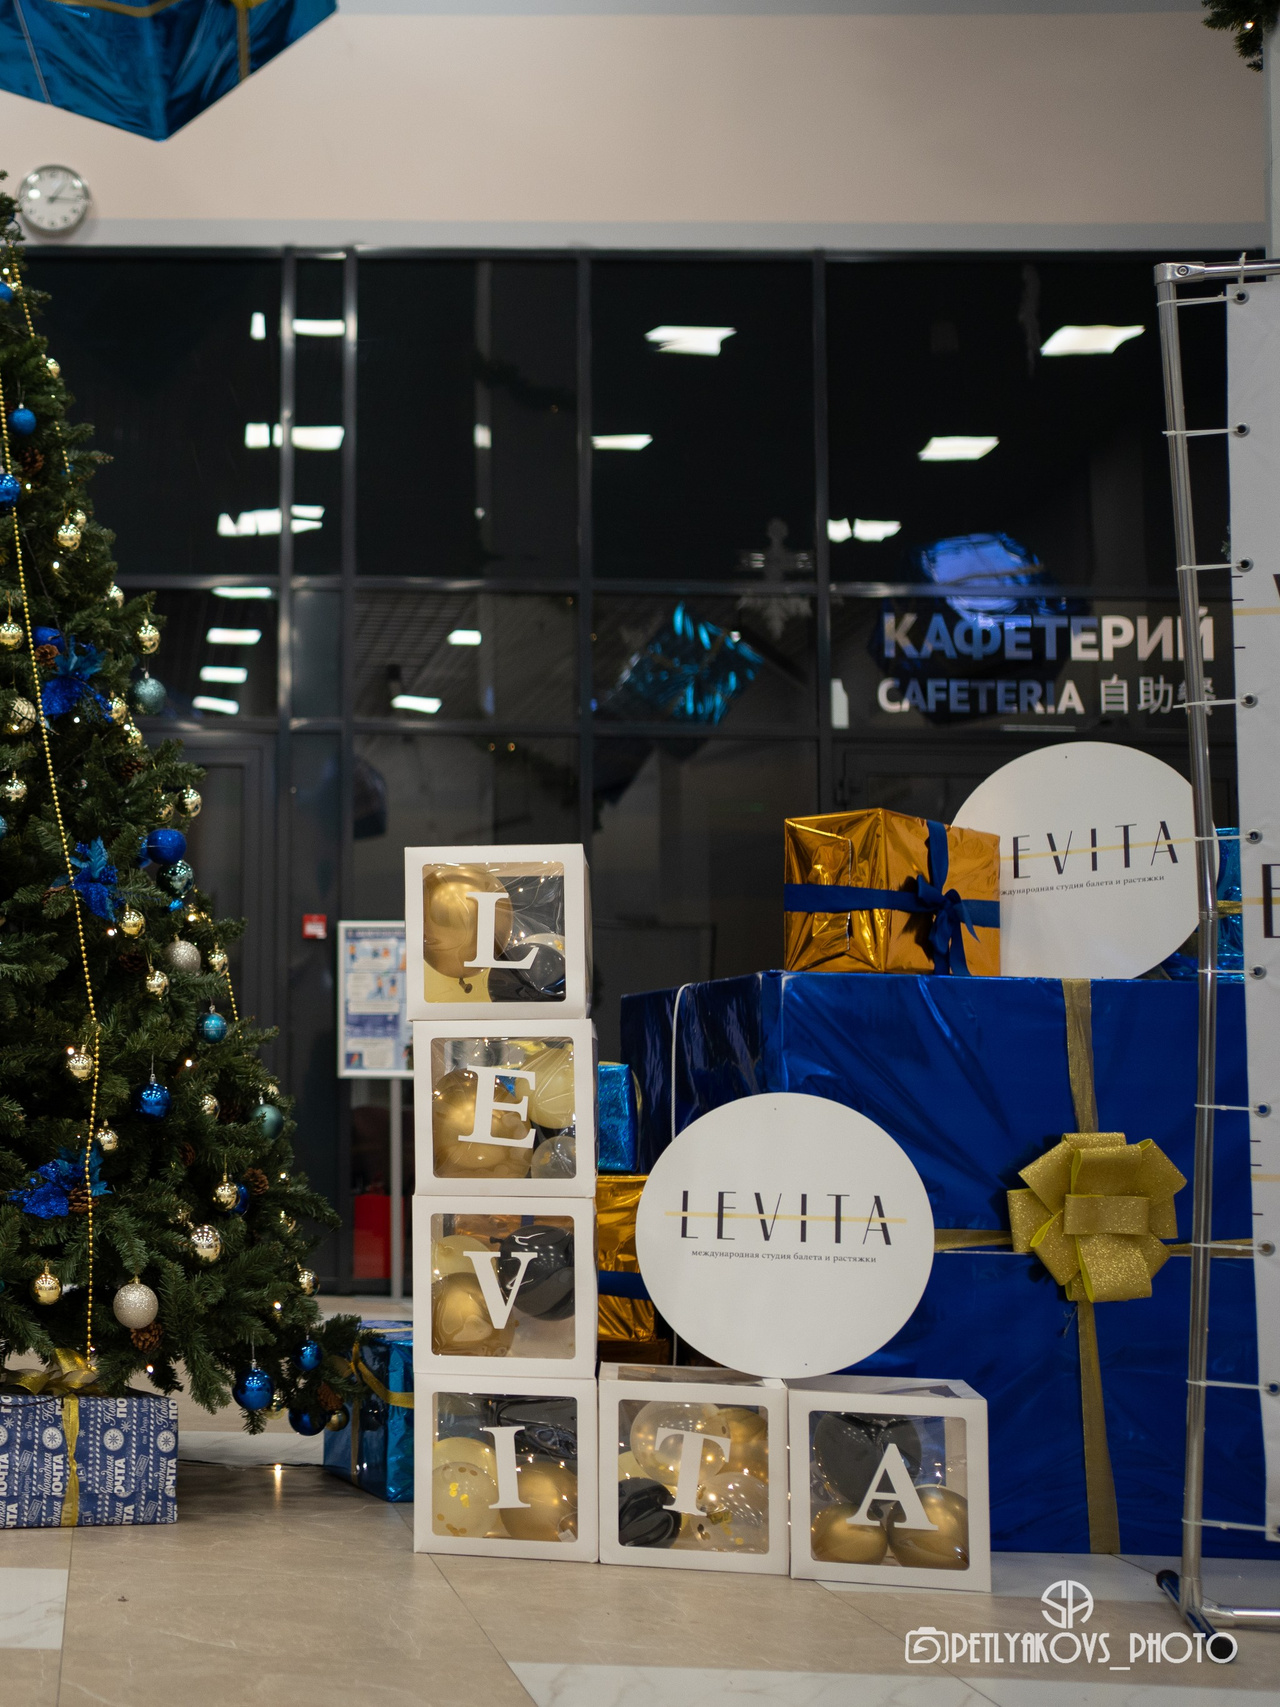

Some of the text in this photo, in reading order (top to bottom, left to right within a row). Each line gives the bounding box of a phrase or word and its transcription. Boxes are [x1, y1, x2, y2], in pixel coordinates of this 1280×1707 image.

[883, 605, 1215, 662] КАФЕТЕРИЙ
[877, 676, 1086, 715] CAFETERIA
[1012, 820, 1179, 879] EVITA
[1000, 886, 1054, 897] ждународная
[1056, 882, 1084, 892] студия
[1085, 879, 1114, 888] балета
[1123, 875, 1166, 886] растяжки
[680, 1190, 892, 1246] LEVITA
[691, 1250, 760, 1259] международная
[761, 1252, 792, 1262] студия
[793, 1252, 823, 1261] балета
[832, 1256, 877, 1264] растяжки
[114, 1458, 126, 1494] ОЧТА
